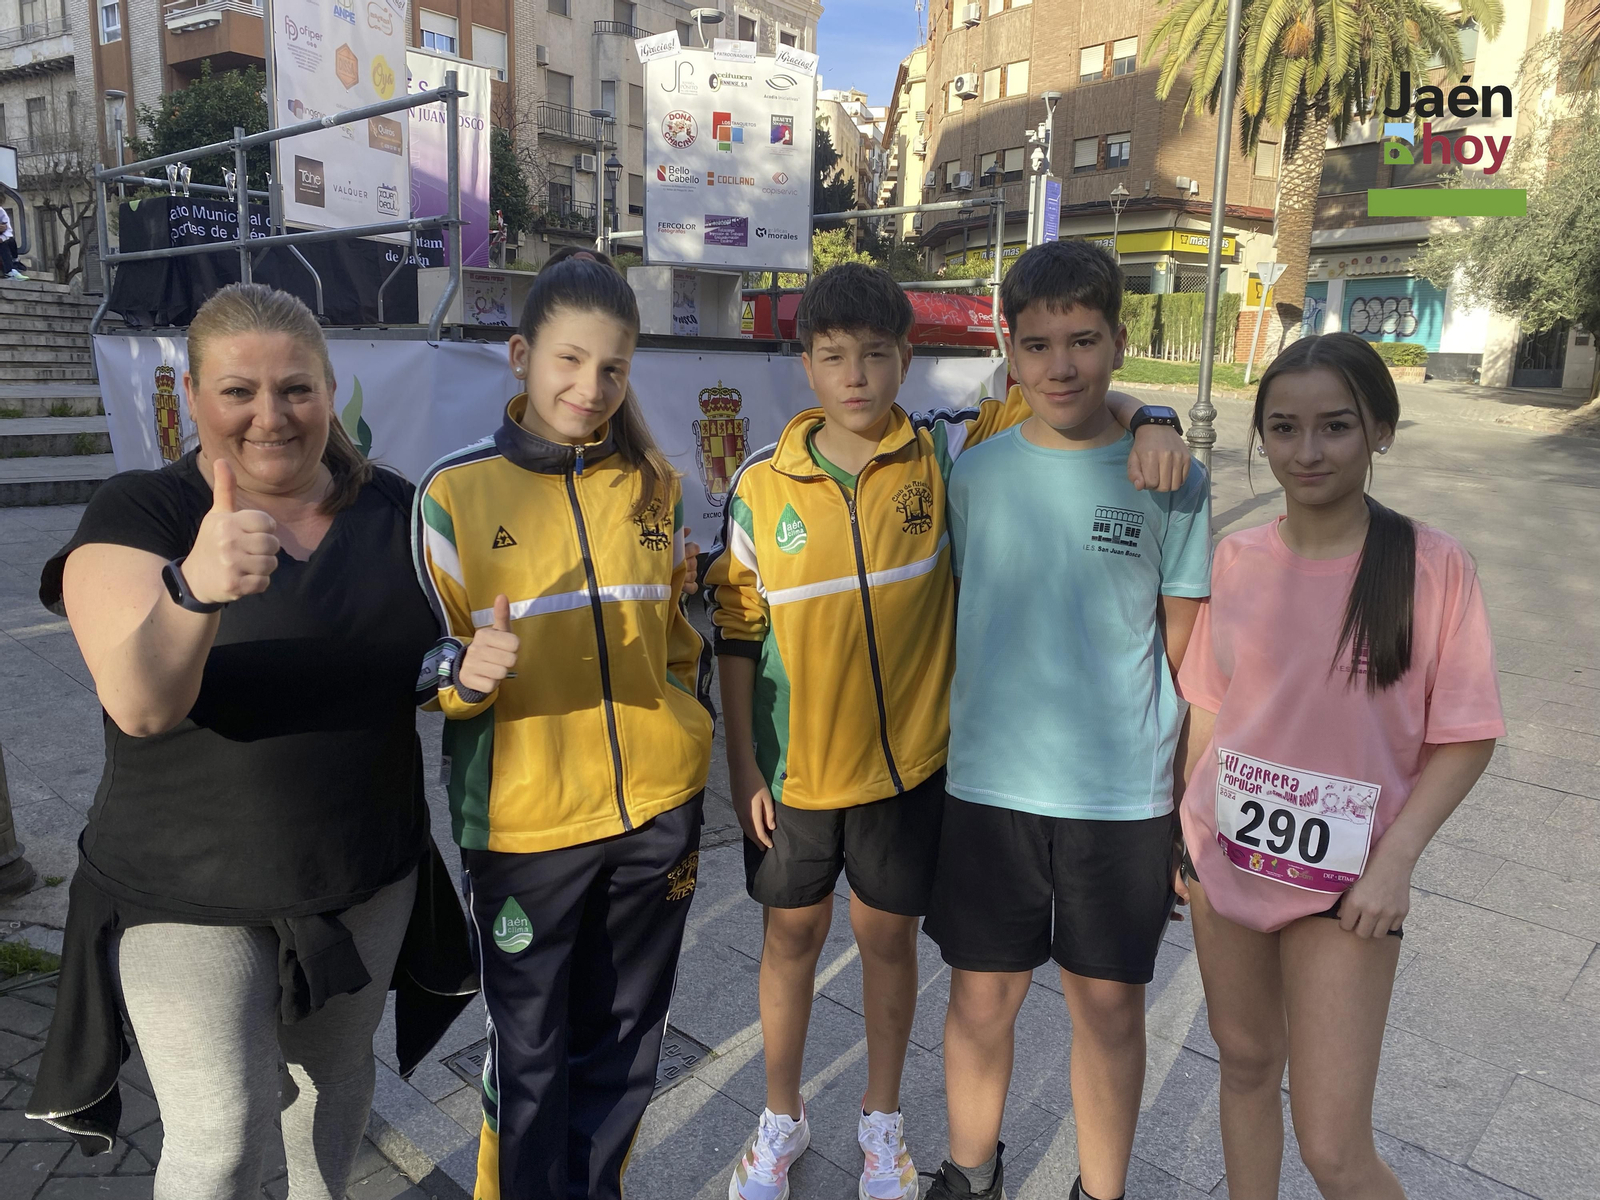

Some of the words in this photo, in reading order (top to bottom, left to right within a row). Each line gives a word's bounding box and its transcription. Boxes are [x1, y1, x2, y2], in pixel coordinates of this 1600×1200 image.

[333, 5, 355, 22] ANPE
[299, 25, 323, 41] ofiper
[640, 38, 675, 57] ¡Gracias!
[716, 51, 753, 60] PATROCINADORES
[778, 51, 814, 72] ¡Gracias!
[418, 108, 446, 124] JUAN
[458, 115, 484, 131] OSCO
[663, 131, 696, 149] CHACINA
[298, 169, 322, 186] Tahe
[668, 165, 690, 175] Bello
[668, 174, 700, 184] Cabello
[717, 175, 755, 186] COCILAND
[333, 184, 368, 199] VALQUER
[169, 205, 189, 221] ato
[192, 205, 261, 226] Municial
[210, 225, 228, 239] de
[232, 228, 266, 240] Jén
[657, 221, 697, 231] FERCOLOR
[767, 232, 798, 241] morales
[385, 250, 399, 263] de
[702, 511, 722, 520] EXCMO
[777, 520, 804, 543] Jaén
[1097, 546, 1109, 554] San
[1109, 548, 1125, 556] Juan
[1125, 550, 1142, 559] Bosco
[1219, 789, 1237, 801] 2024
[1299, 785, 1319, 808] BOSCO
[1235, 800, 1331, 864] 290
[495, 916, 529, 937] Jaén
